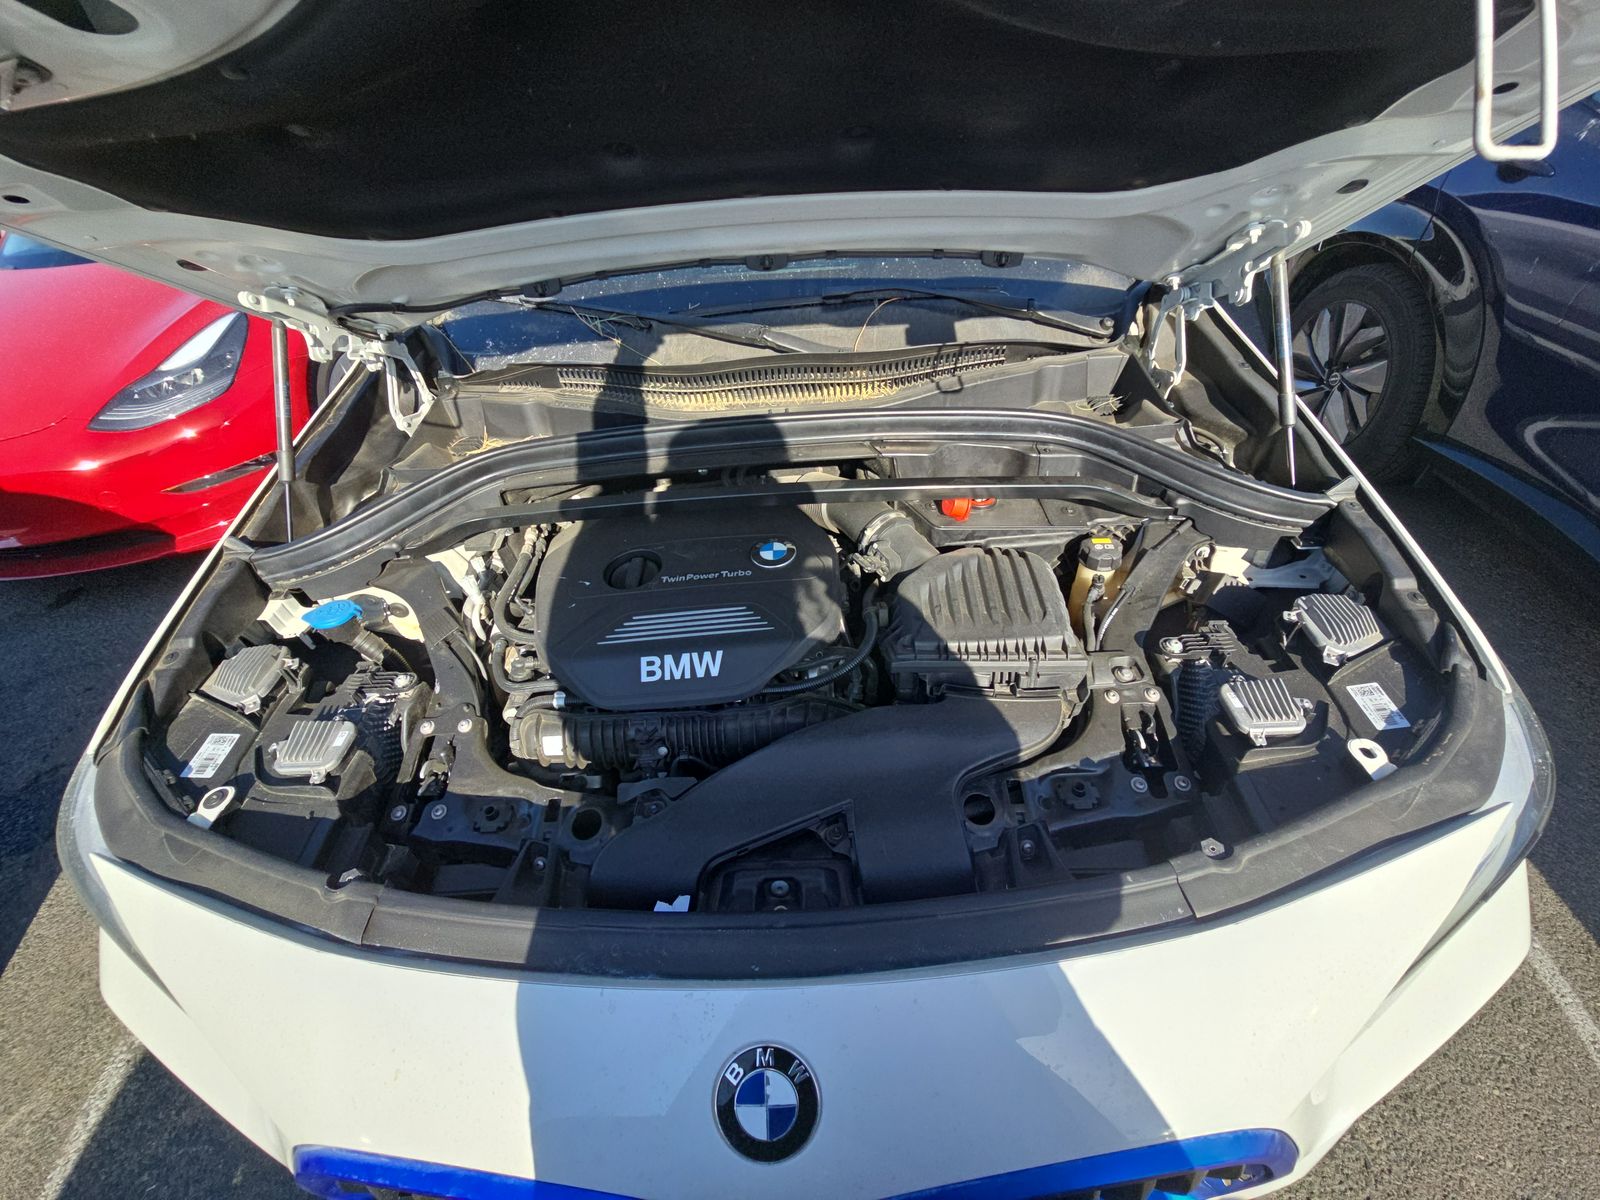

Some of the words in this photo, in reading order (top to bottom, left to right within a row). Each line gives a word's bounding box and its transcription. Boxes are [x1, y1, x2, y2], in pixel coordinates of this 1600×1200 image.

[720, 569, 752, 578] Turbo
[640, 650, 723, 683] BMW
[724, 1047, 810, 1087] BMW
